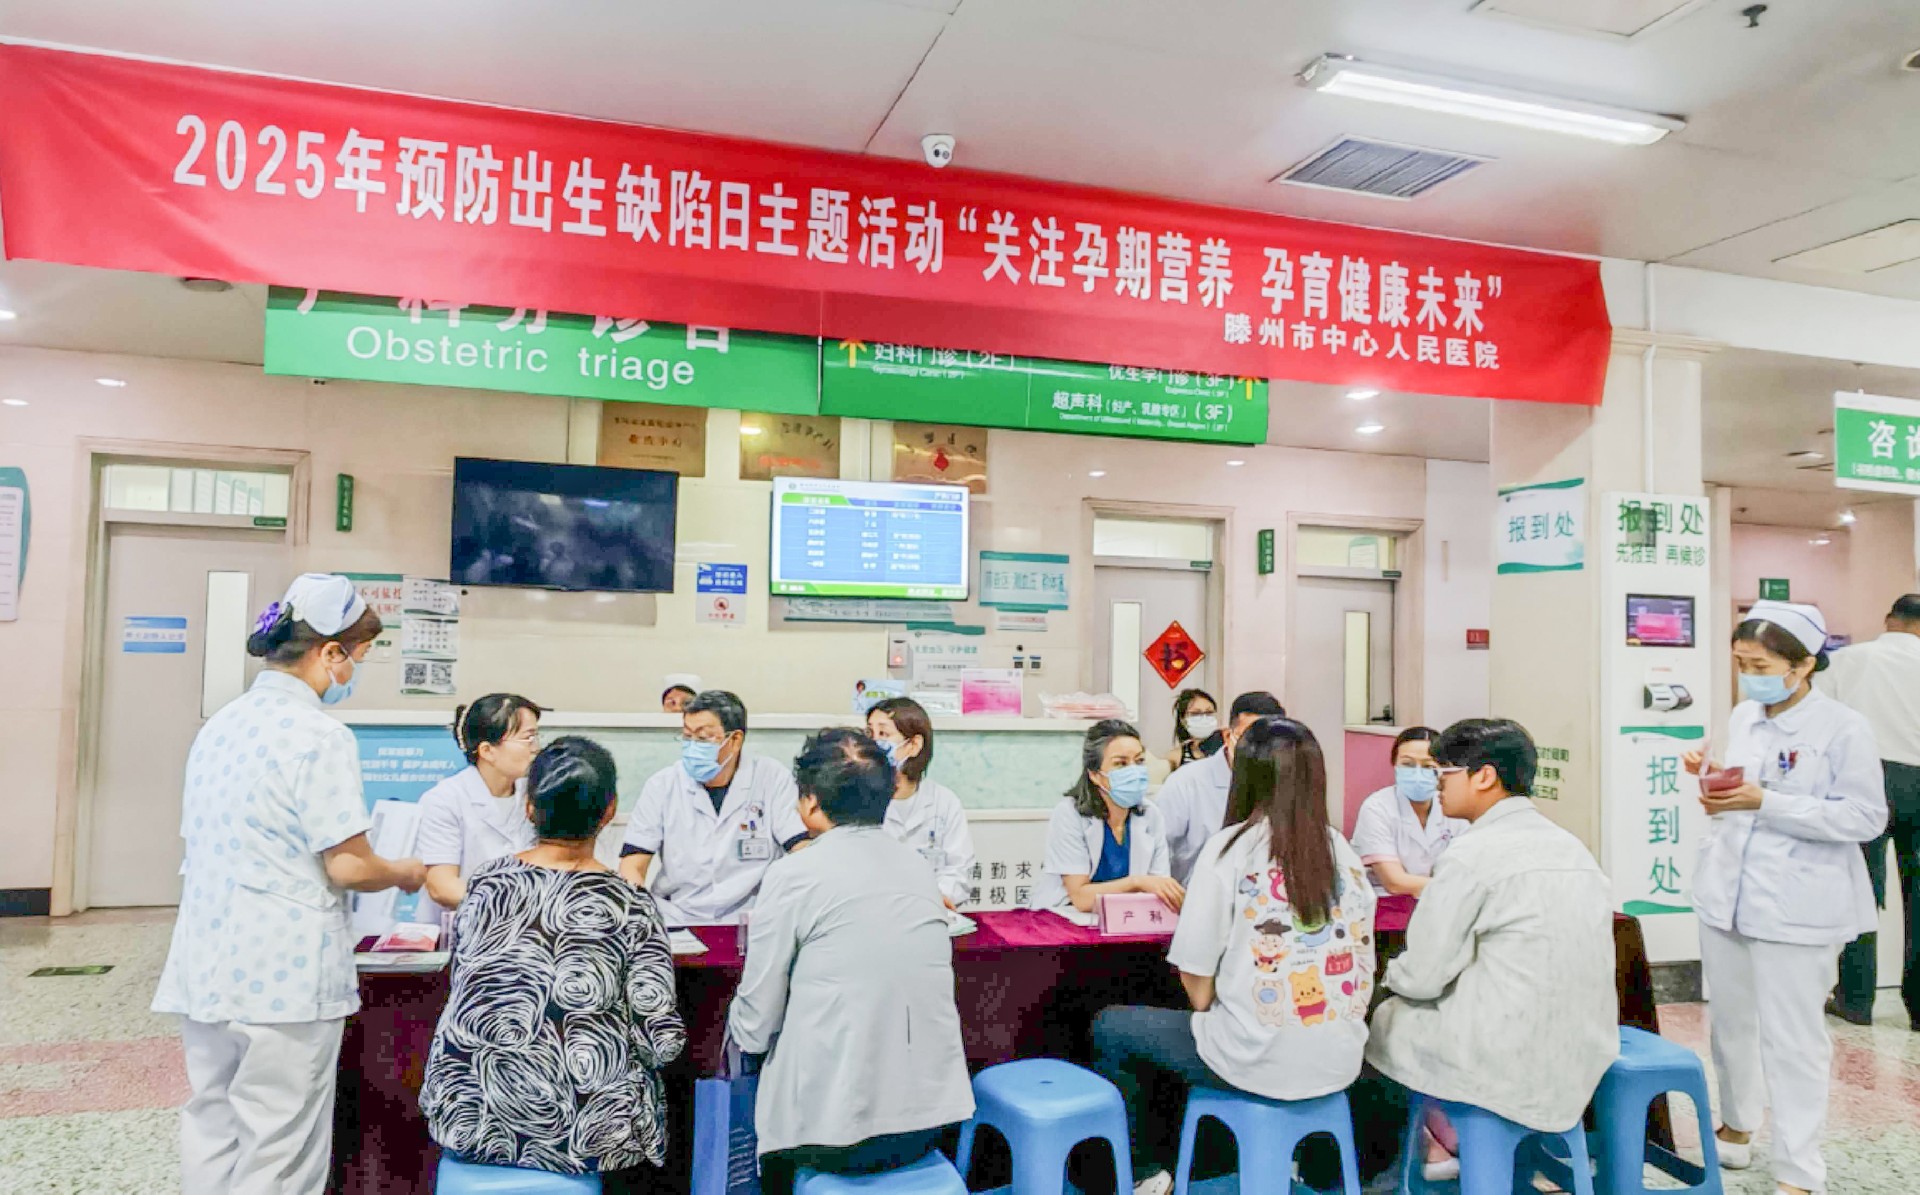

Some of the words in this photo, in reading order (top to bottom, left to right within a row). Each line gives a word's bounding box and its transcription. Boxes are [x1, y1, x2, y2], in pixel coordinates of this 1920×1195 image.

[346, 325, 548, 374] Obstetric
[578, 346, 695, 390] triage
[1223, 312, 1500, 370] 滕州市中心人民医院
[1508, 511, 1575, 543] 报到处
[1617, 498, 1705, 536] 报到处
[1646, 755, 1681, 895] 报到处
[1122, 910, 1163, 924] 产科
